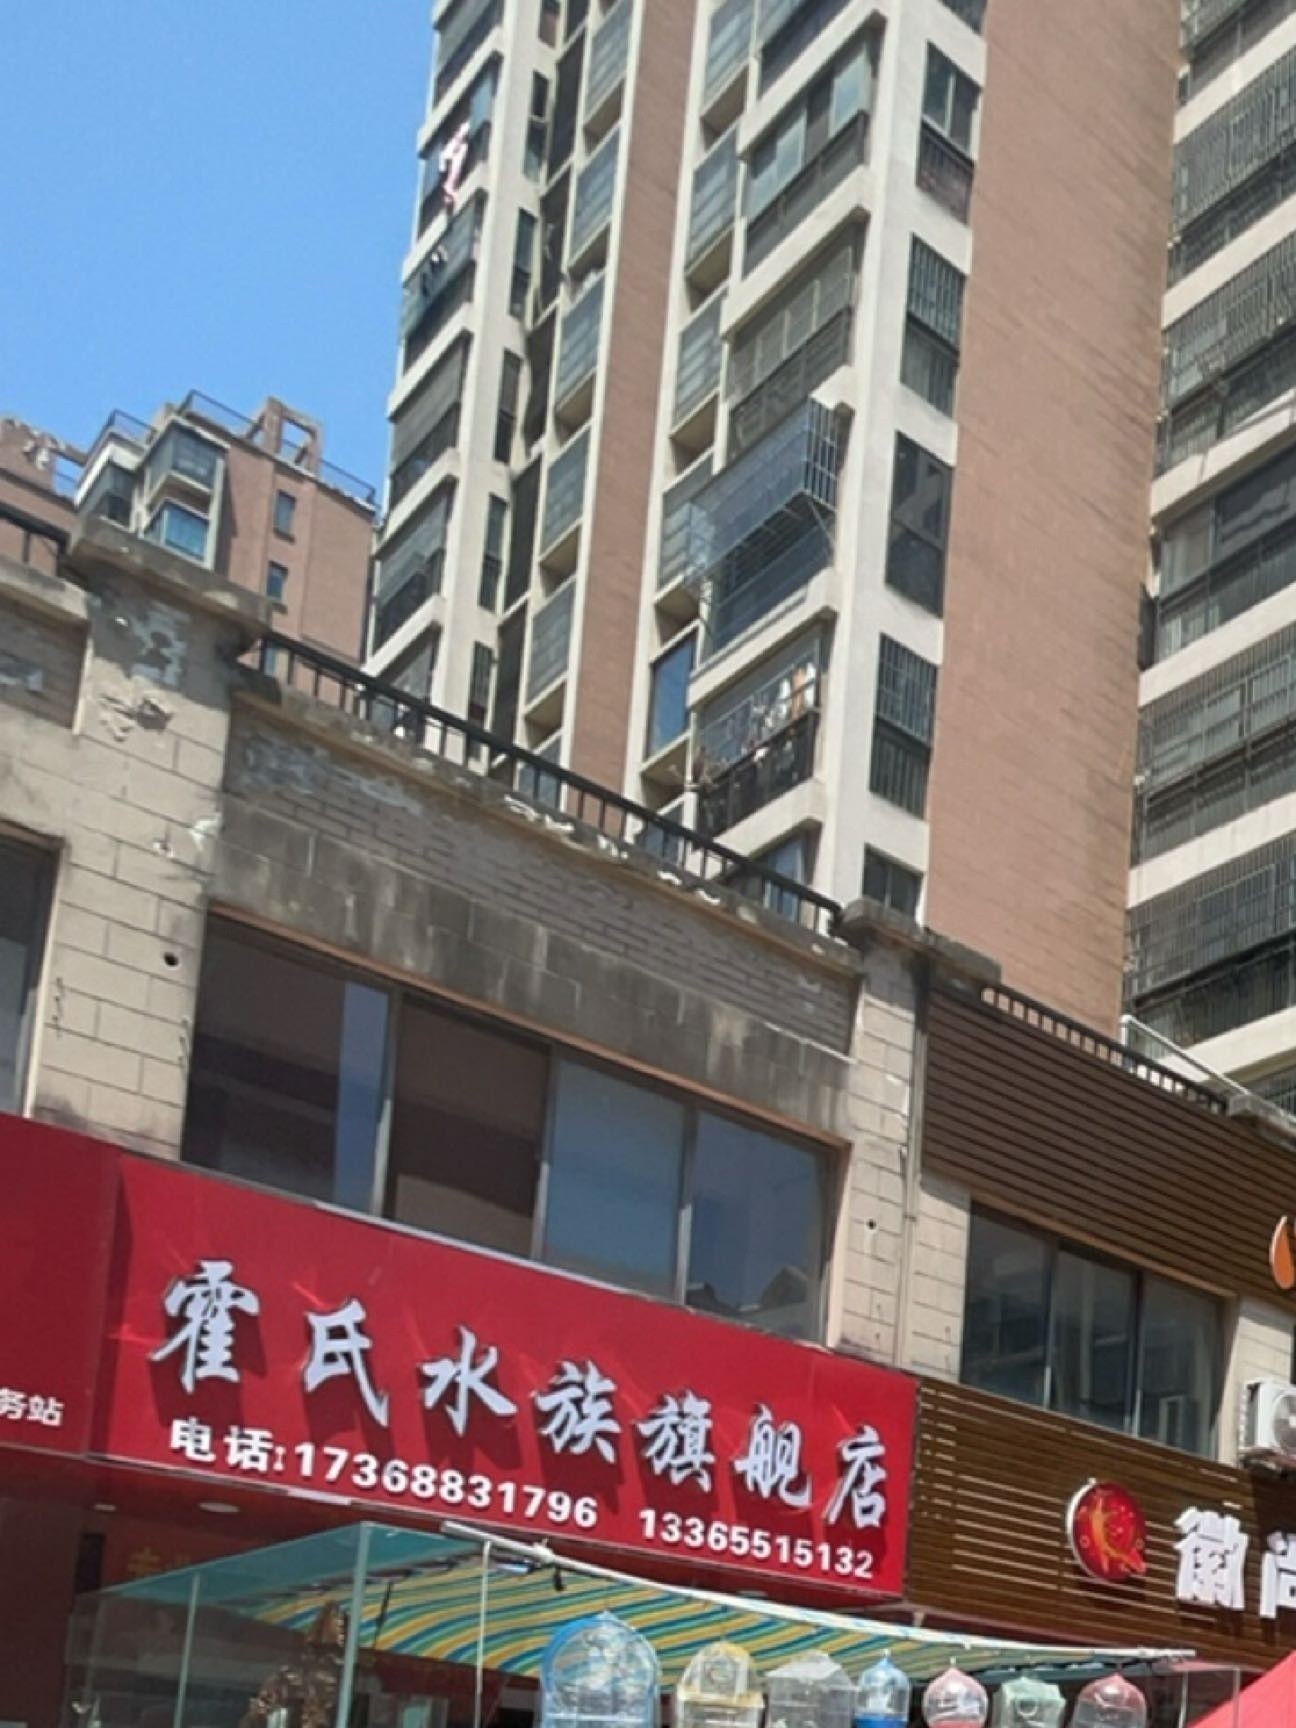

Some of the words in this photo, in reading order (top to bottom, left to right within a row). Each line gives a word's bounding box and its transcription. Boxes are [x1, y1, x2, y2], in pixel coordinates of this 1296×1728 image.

[149, 1259, 888, 1530] 霍氏水族旗舰店
[638, 1508, 874, 1579] 13365515132
